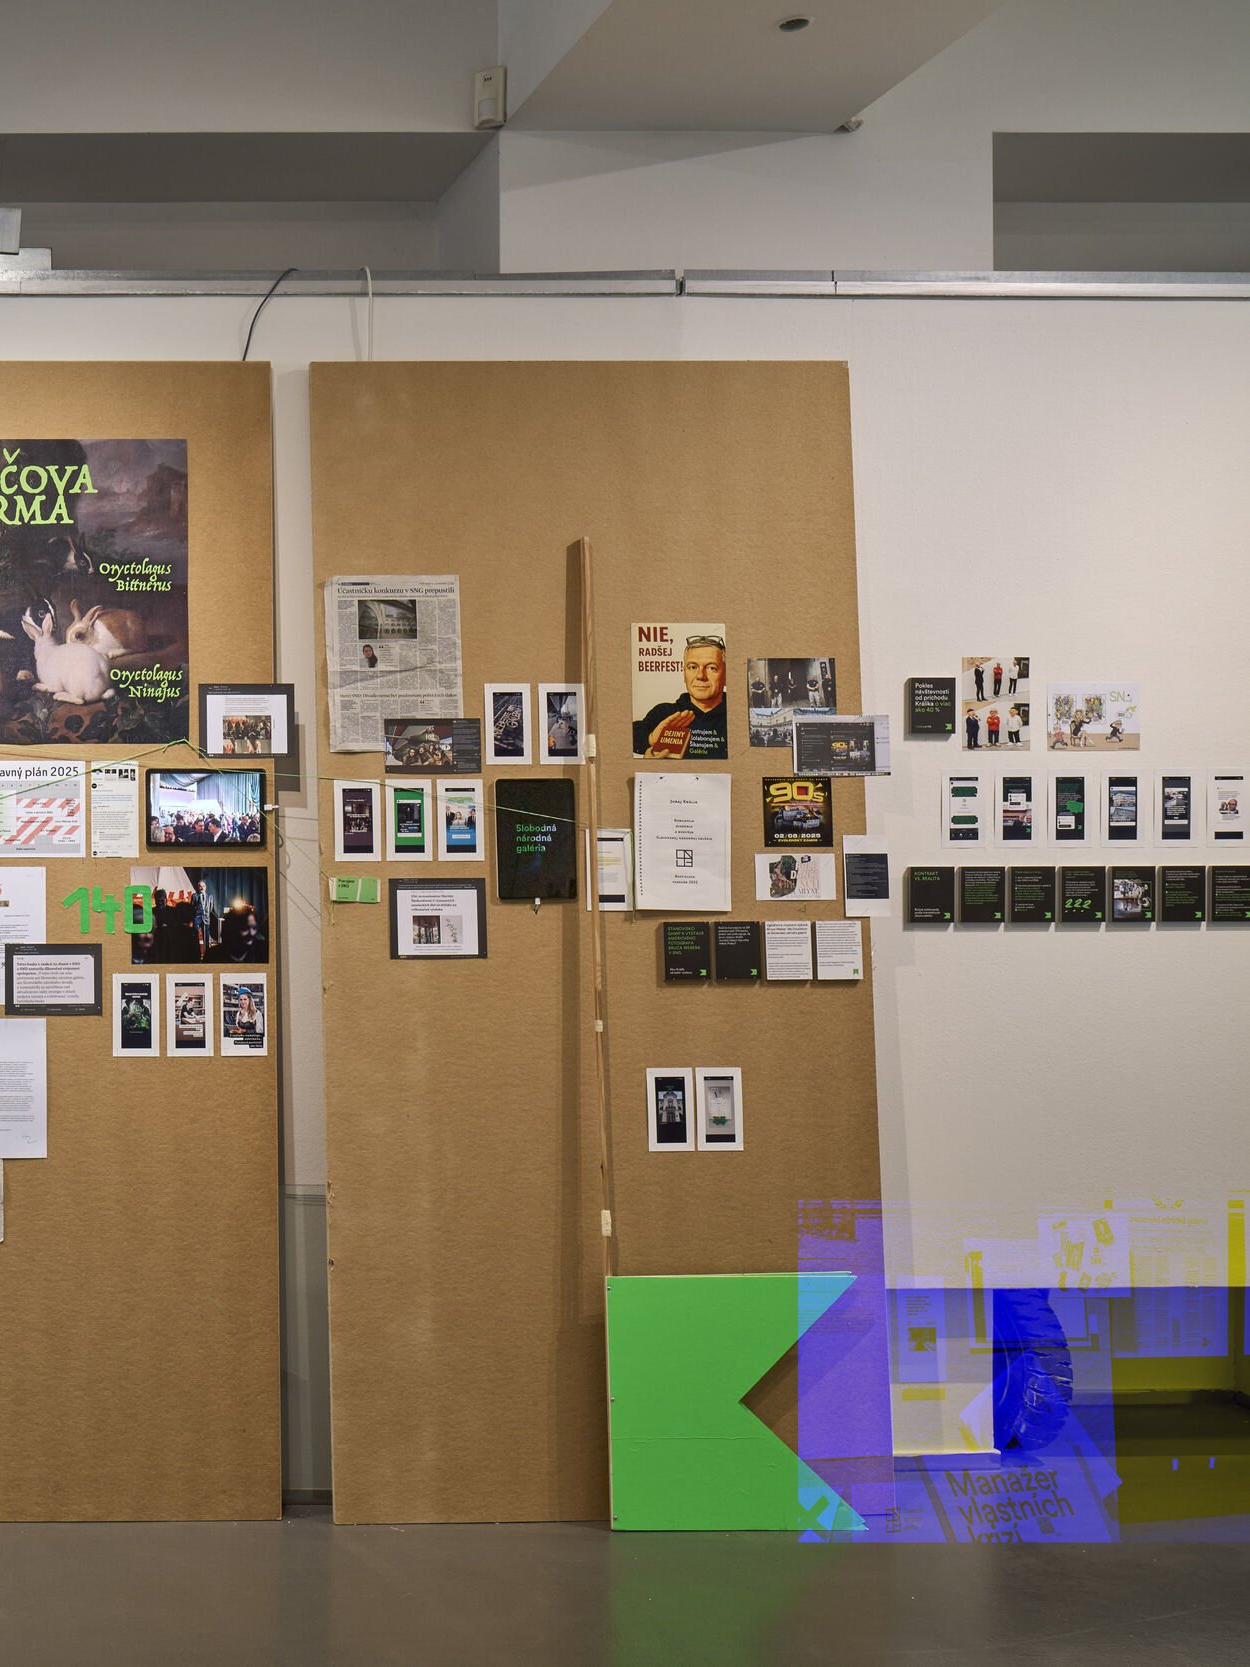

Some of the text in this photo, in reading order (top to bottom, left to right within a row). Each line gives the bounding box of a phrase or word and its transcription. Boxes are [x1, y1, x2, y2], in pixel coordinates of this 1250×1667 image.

[99, 558, 172, 582] Oryctolagus
[116, 577, 172, 592] Bittnerus
[638, 626, 674, 644] NIE,
[638, 646, 672, 657] RADŠEJ
[638, 660, 684, 673] BEERFEST!
[110, 664, 182, 688] Oryctolagus
[128, 683, 180, 702] Ninajus
[664, 730, 686, 738] DEJINY
[660, 737, 684, 746] UMENIA
[25, 766, 48, 780] plán
[50, 766, 79, 778] 2025
[516, 824, 557, 832] Slobodná
[516, 834, 552, 842] národná
[516, 844, 546, 854] galéria
[61, 885, 152, 934] 140
[945, 1465, 1058, 1497] Manažer
[958, 1490, 1074, 1525] vlastních
